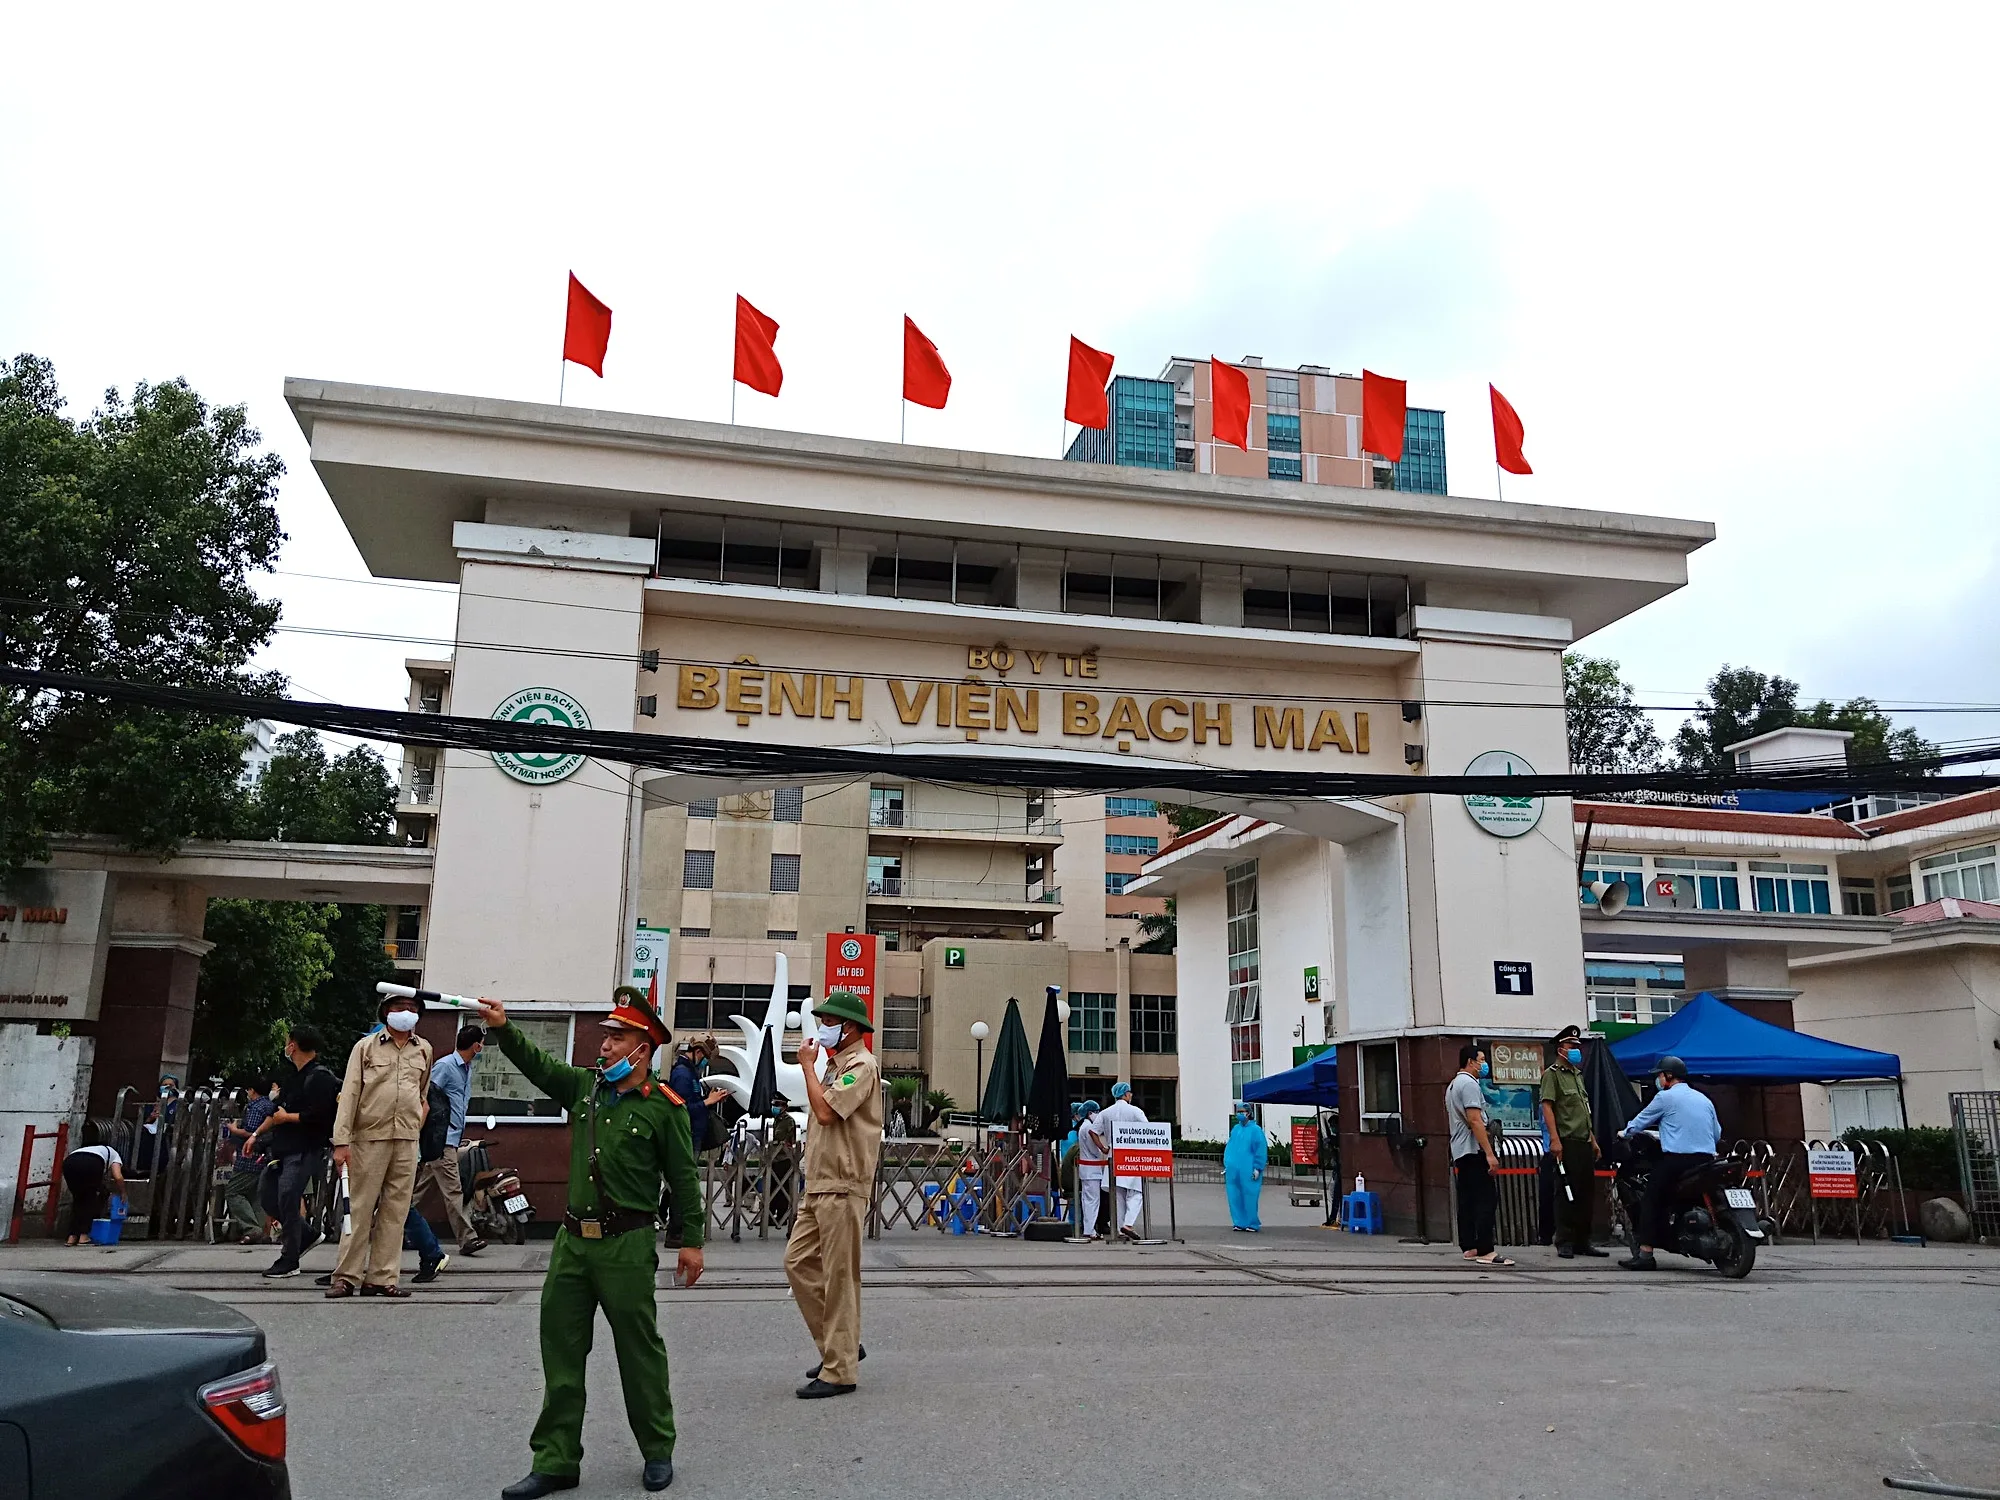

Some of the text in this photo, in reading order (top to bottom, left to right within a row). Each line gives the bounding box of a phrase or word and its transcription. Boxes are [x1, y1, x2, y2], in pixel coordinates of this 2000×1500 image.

[968, 643, 1099, 678] BỘ Y TẾ
[515, 692, 541, 705] VIỆN
[544, 693, 573, 710] BẠCH
[677, 655, 1369, 753] BỆNH VIỆN BẠCH MAI
[518, 768, 538, 779] MAI
[541, 754, 582, 779] HOSPITA
[1636, 789, 1689, 803] REQUIRED
[1690, 793, 1740, 806] SERVICES
[23, 906, 68, 924] MAI
[950, 949, 960, 965] P
[836, 966, 865, 977] HÃY ĐEO
[848, 985, 871, 995] TRANG
[1305, 975, 1317, 993] K3
[1503, 974, 1521, 991] 1
[1514, 1049, 1537, 1061] CẤM
[1510, 1064, 1532, 1079] THUỐC
[1136, 1137, 1146, 1145] TRA
[1157, 1129, 1166, 1137] LẠI
[1124, 1155, 1141, 1163] PLEASE
[1153, 1156, 1163, 1164] FOR
